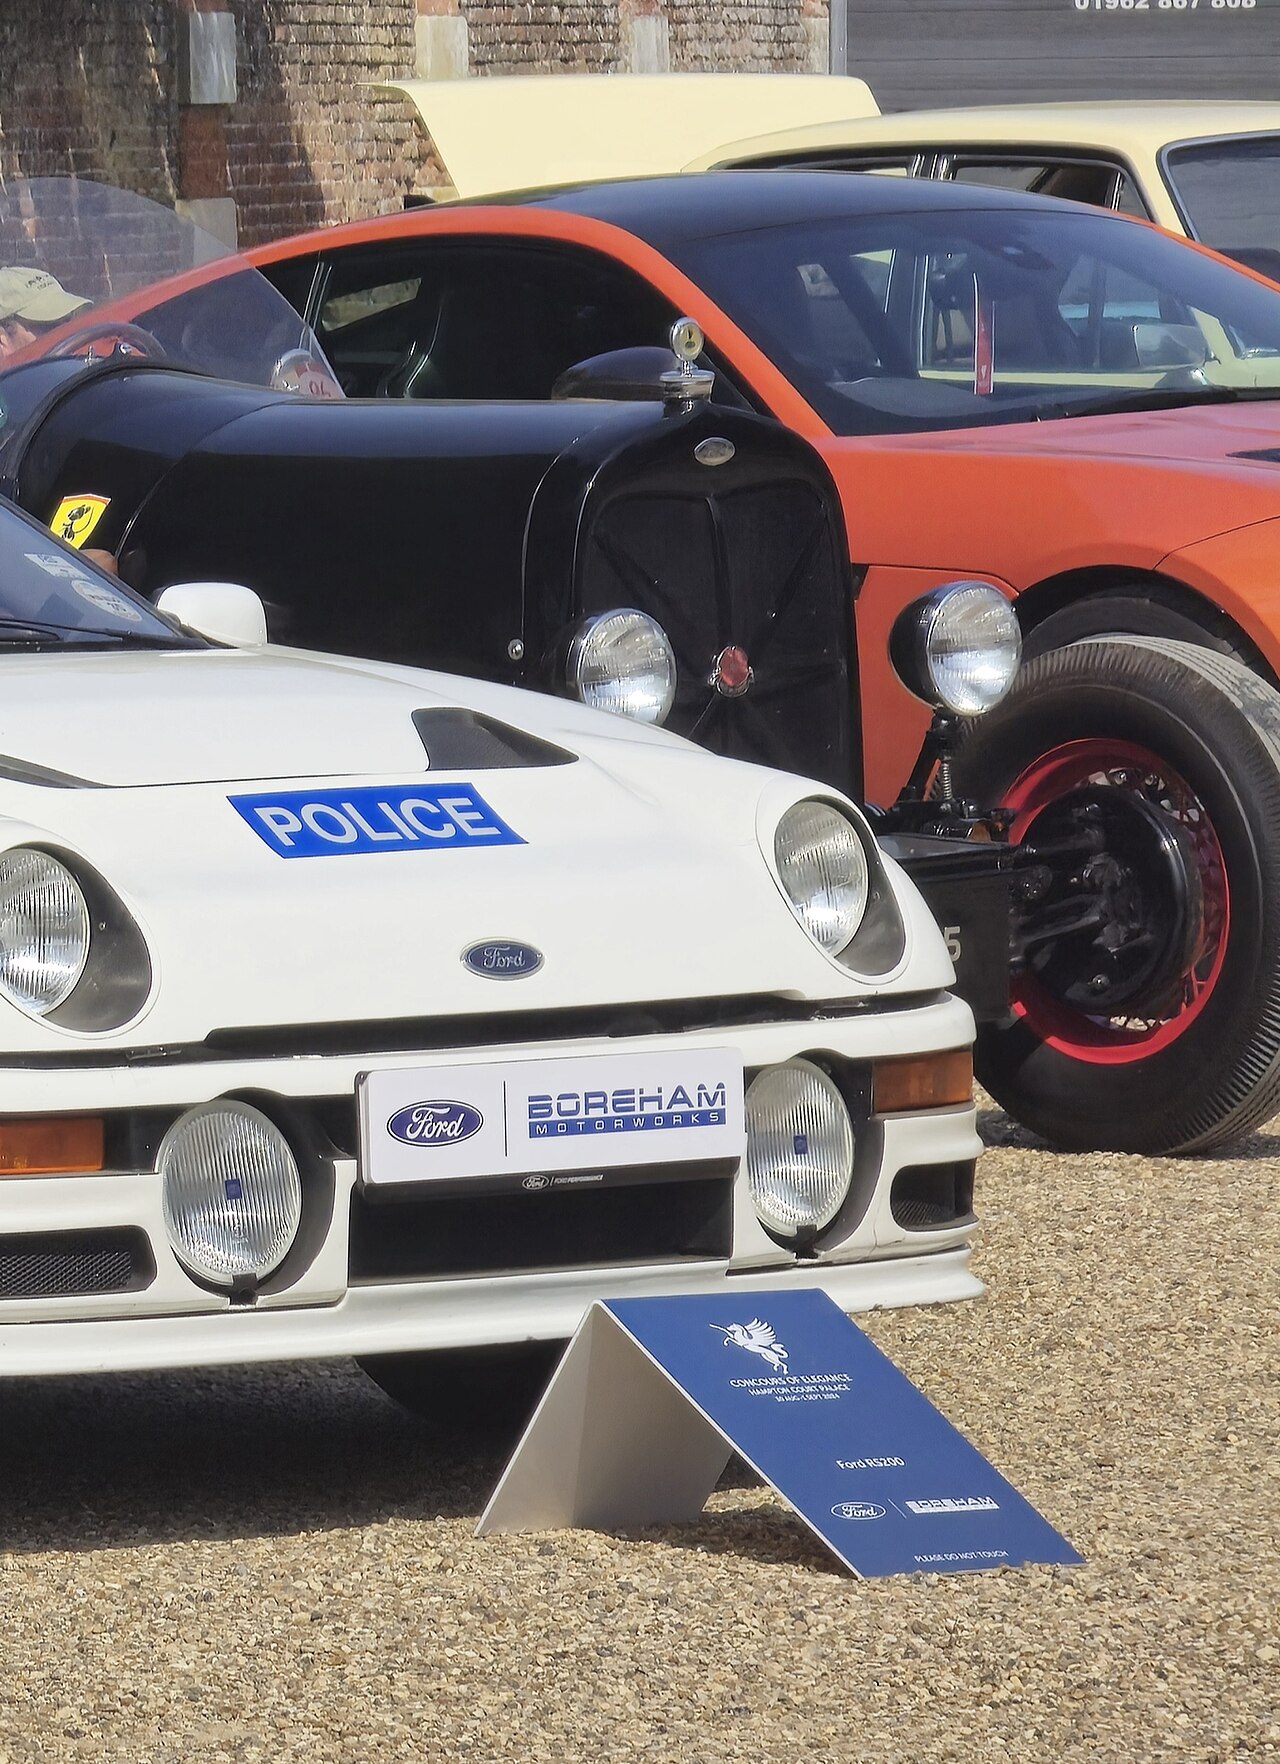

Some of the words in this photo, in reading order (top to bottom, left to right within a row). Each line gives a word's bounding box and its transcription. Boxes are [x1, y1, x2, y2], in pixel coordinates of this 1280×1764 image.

[253, 797, 502, 847] POLICE
[944, 926, 961, 962] 5
[482, 945, 526, 969] Ford
[406, 1105, 466, 1140] Ford
[528, 1082, 726, 1119] BOREHAM
[536, 1111, 721, 1135] MOTORWORKS
[730, 1376, 787, 1388] CONCOURS
[786, 1376, 802, 1385] OF
[800, 1373, 853, 1384] ELEGANCE
[748, 1386, 791, 1397] HAMPTON
[790, 1385, 820, 1394] COURT
[818, 1383, 851, 1392] PALACE
[836, 1459, 868, 1470] Ford
[867, 1457, 906, 1469] RS200
[976, 1550, 1010, 1559] TOUCH
